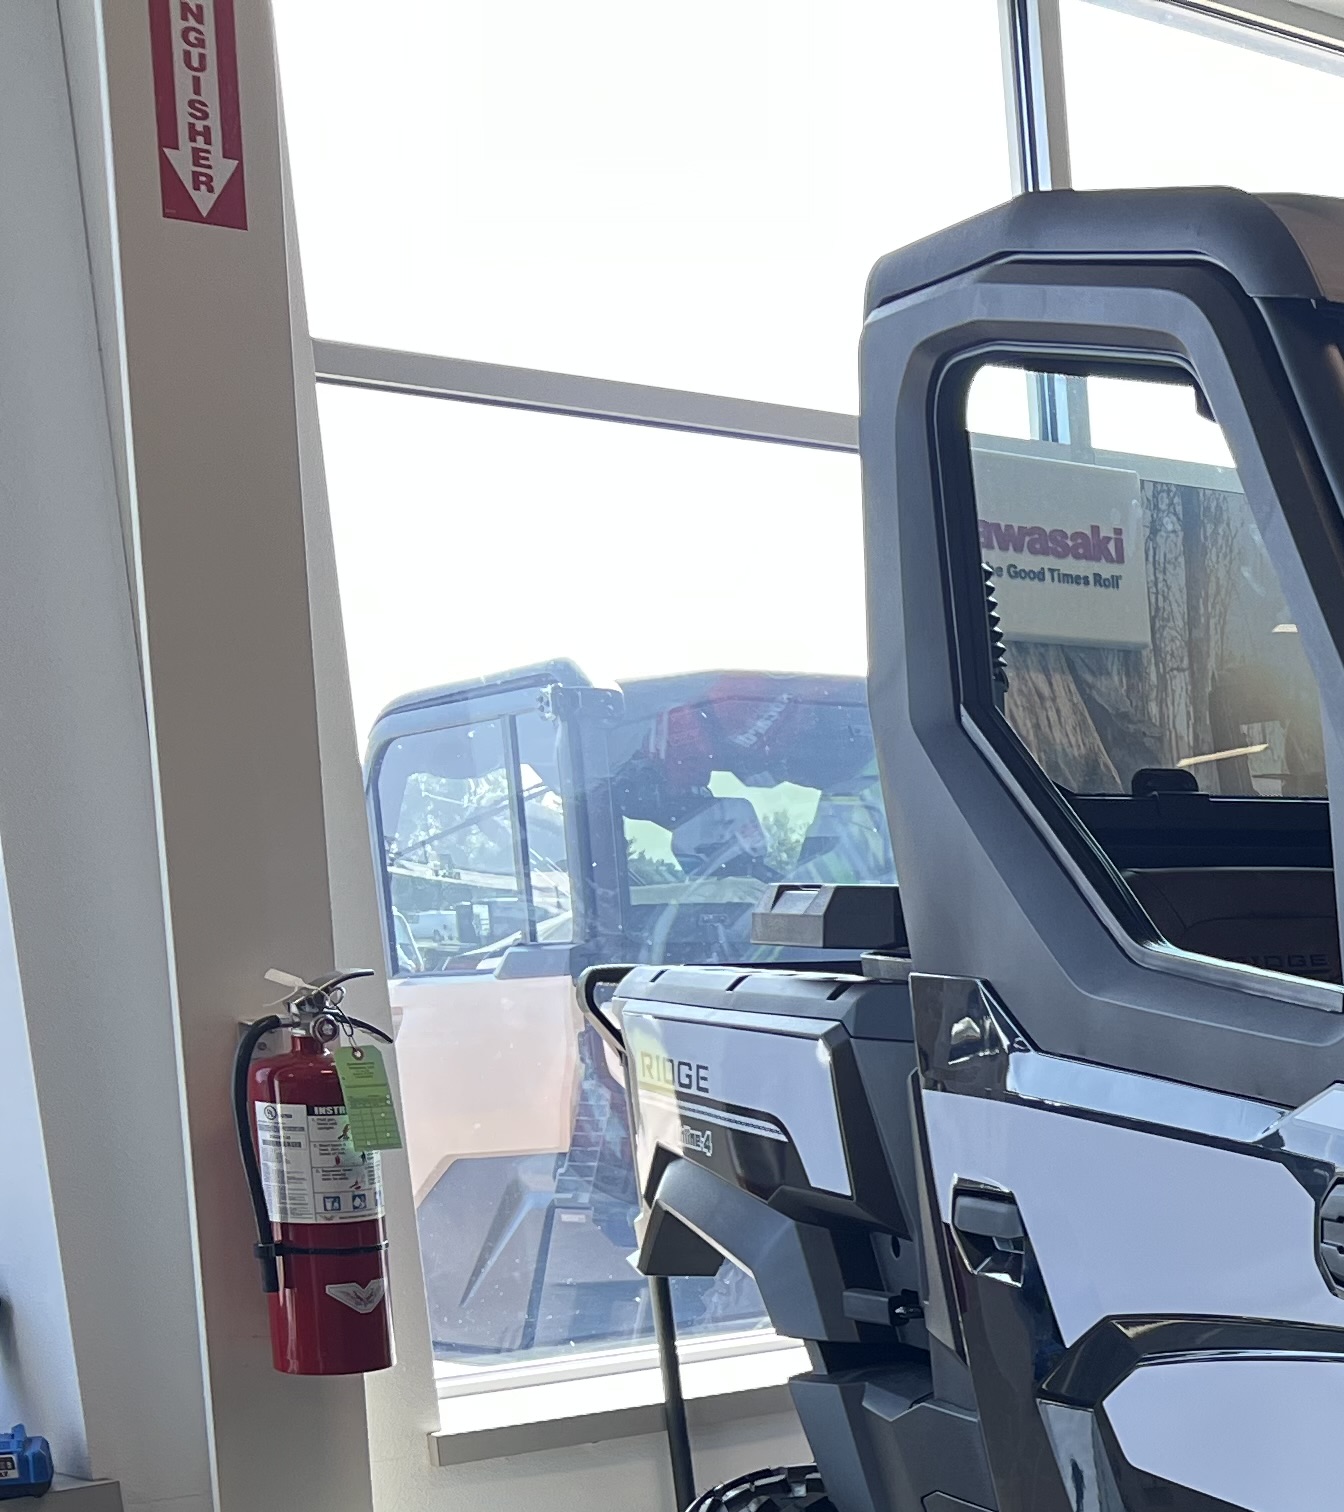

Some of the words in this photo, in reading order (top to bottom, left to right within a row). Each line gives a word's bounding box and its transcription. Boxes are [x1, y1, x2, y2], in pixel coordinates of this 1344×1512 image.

[179, 0, 215, 194] NGUISHER
[978, 519, 1125, 564] awasaki
[1006, 563, 1046, 582] Good
[1047, 567, 1090, 586] Times
[1093, 572, 1120, 590] Roll
[640, 1052, 709, 1093] RIDGE
